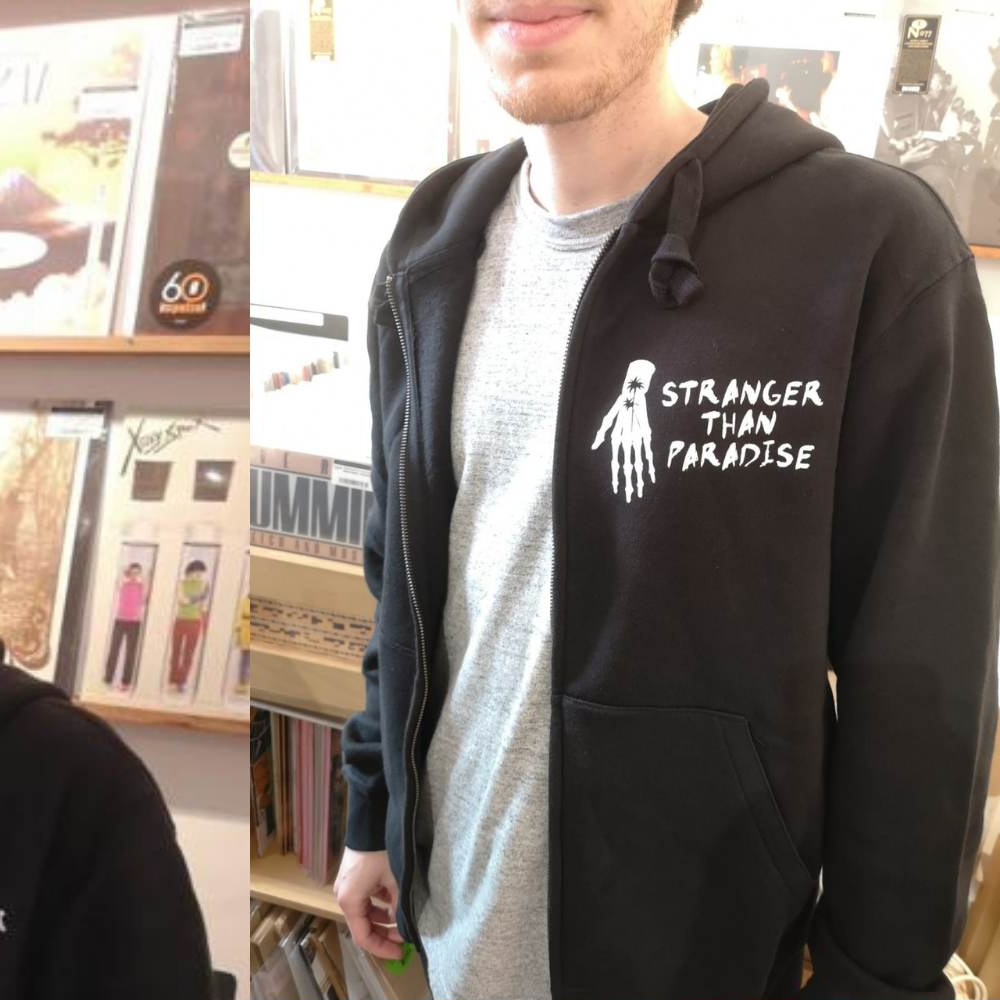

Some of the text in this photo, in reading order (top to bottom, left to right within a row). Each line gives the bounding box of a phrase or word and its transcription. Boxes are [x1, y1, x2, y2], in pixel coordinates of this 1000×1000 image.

[162, 271, 210, 303] 60
[662, 378, 824, 408] STRANGER
[701, 409, 777, 439] THAN
[667, 440, 815, 472] PARADISE
